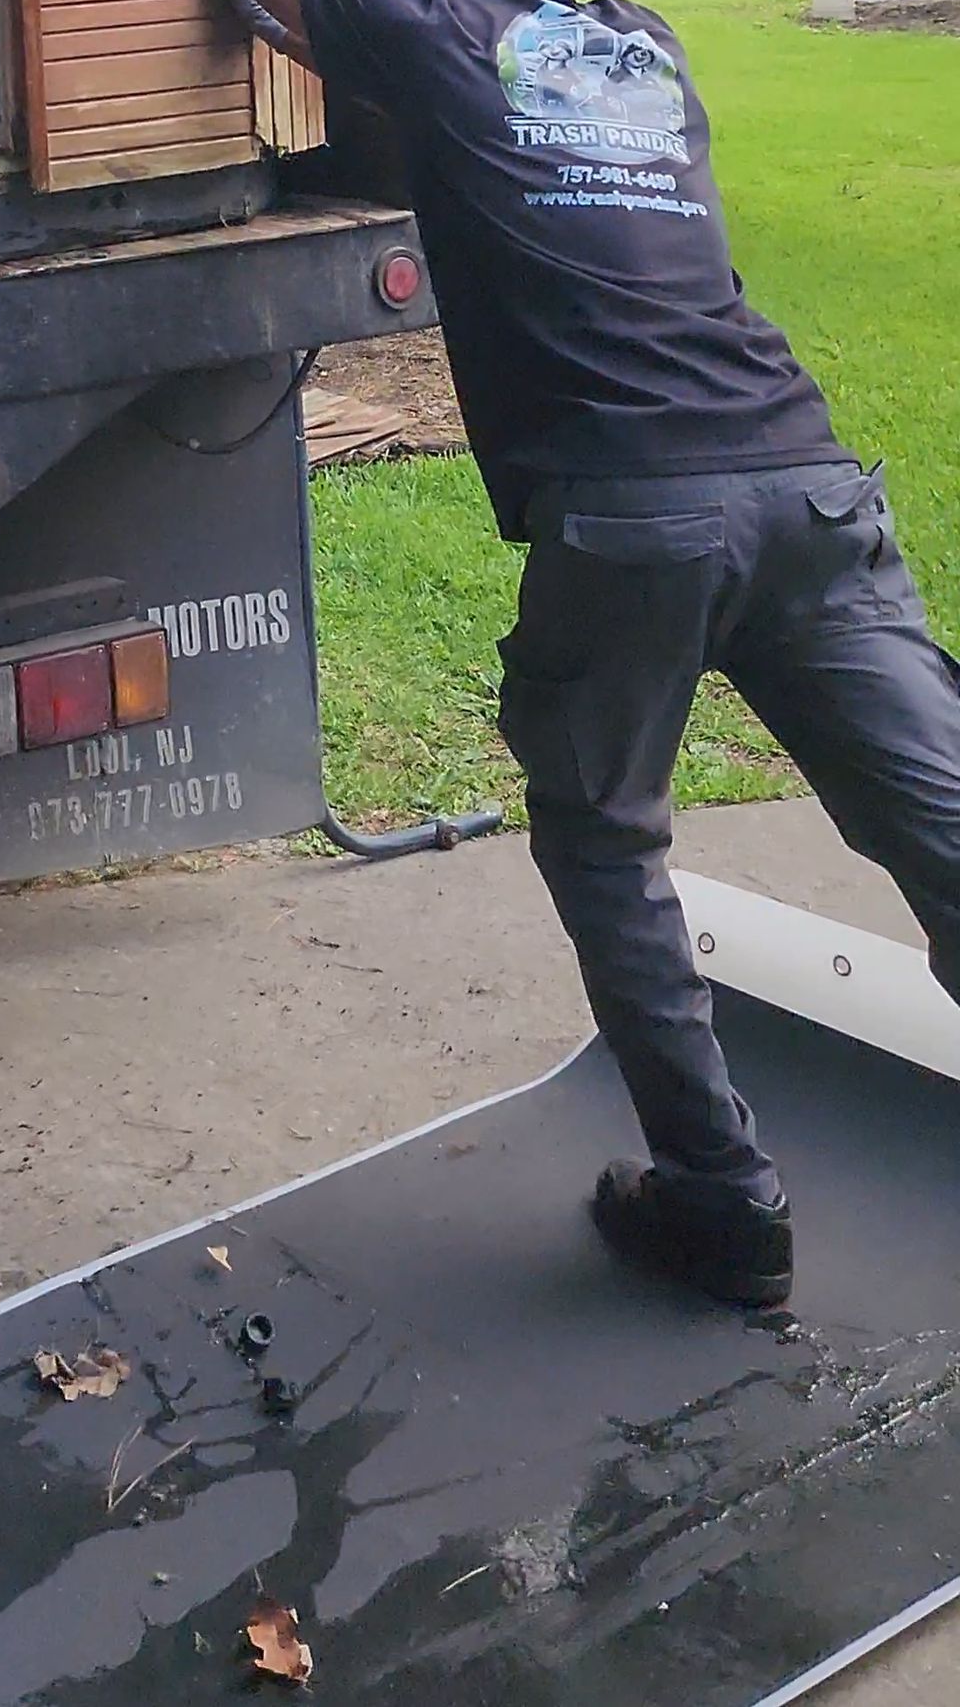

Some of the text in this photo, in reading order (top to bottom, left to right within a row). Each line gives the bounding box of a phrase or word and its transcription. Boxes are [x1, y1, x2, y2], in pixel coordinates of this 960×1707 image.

[511, 124, 686, 158] TRASH PANDAS
[147, 589, 290, 658] MOTORS
[156, 725, 193, 767] NJ
